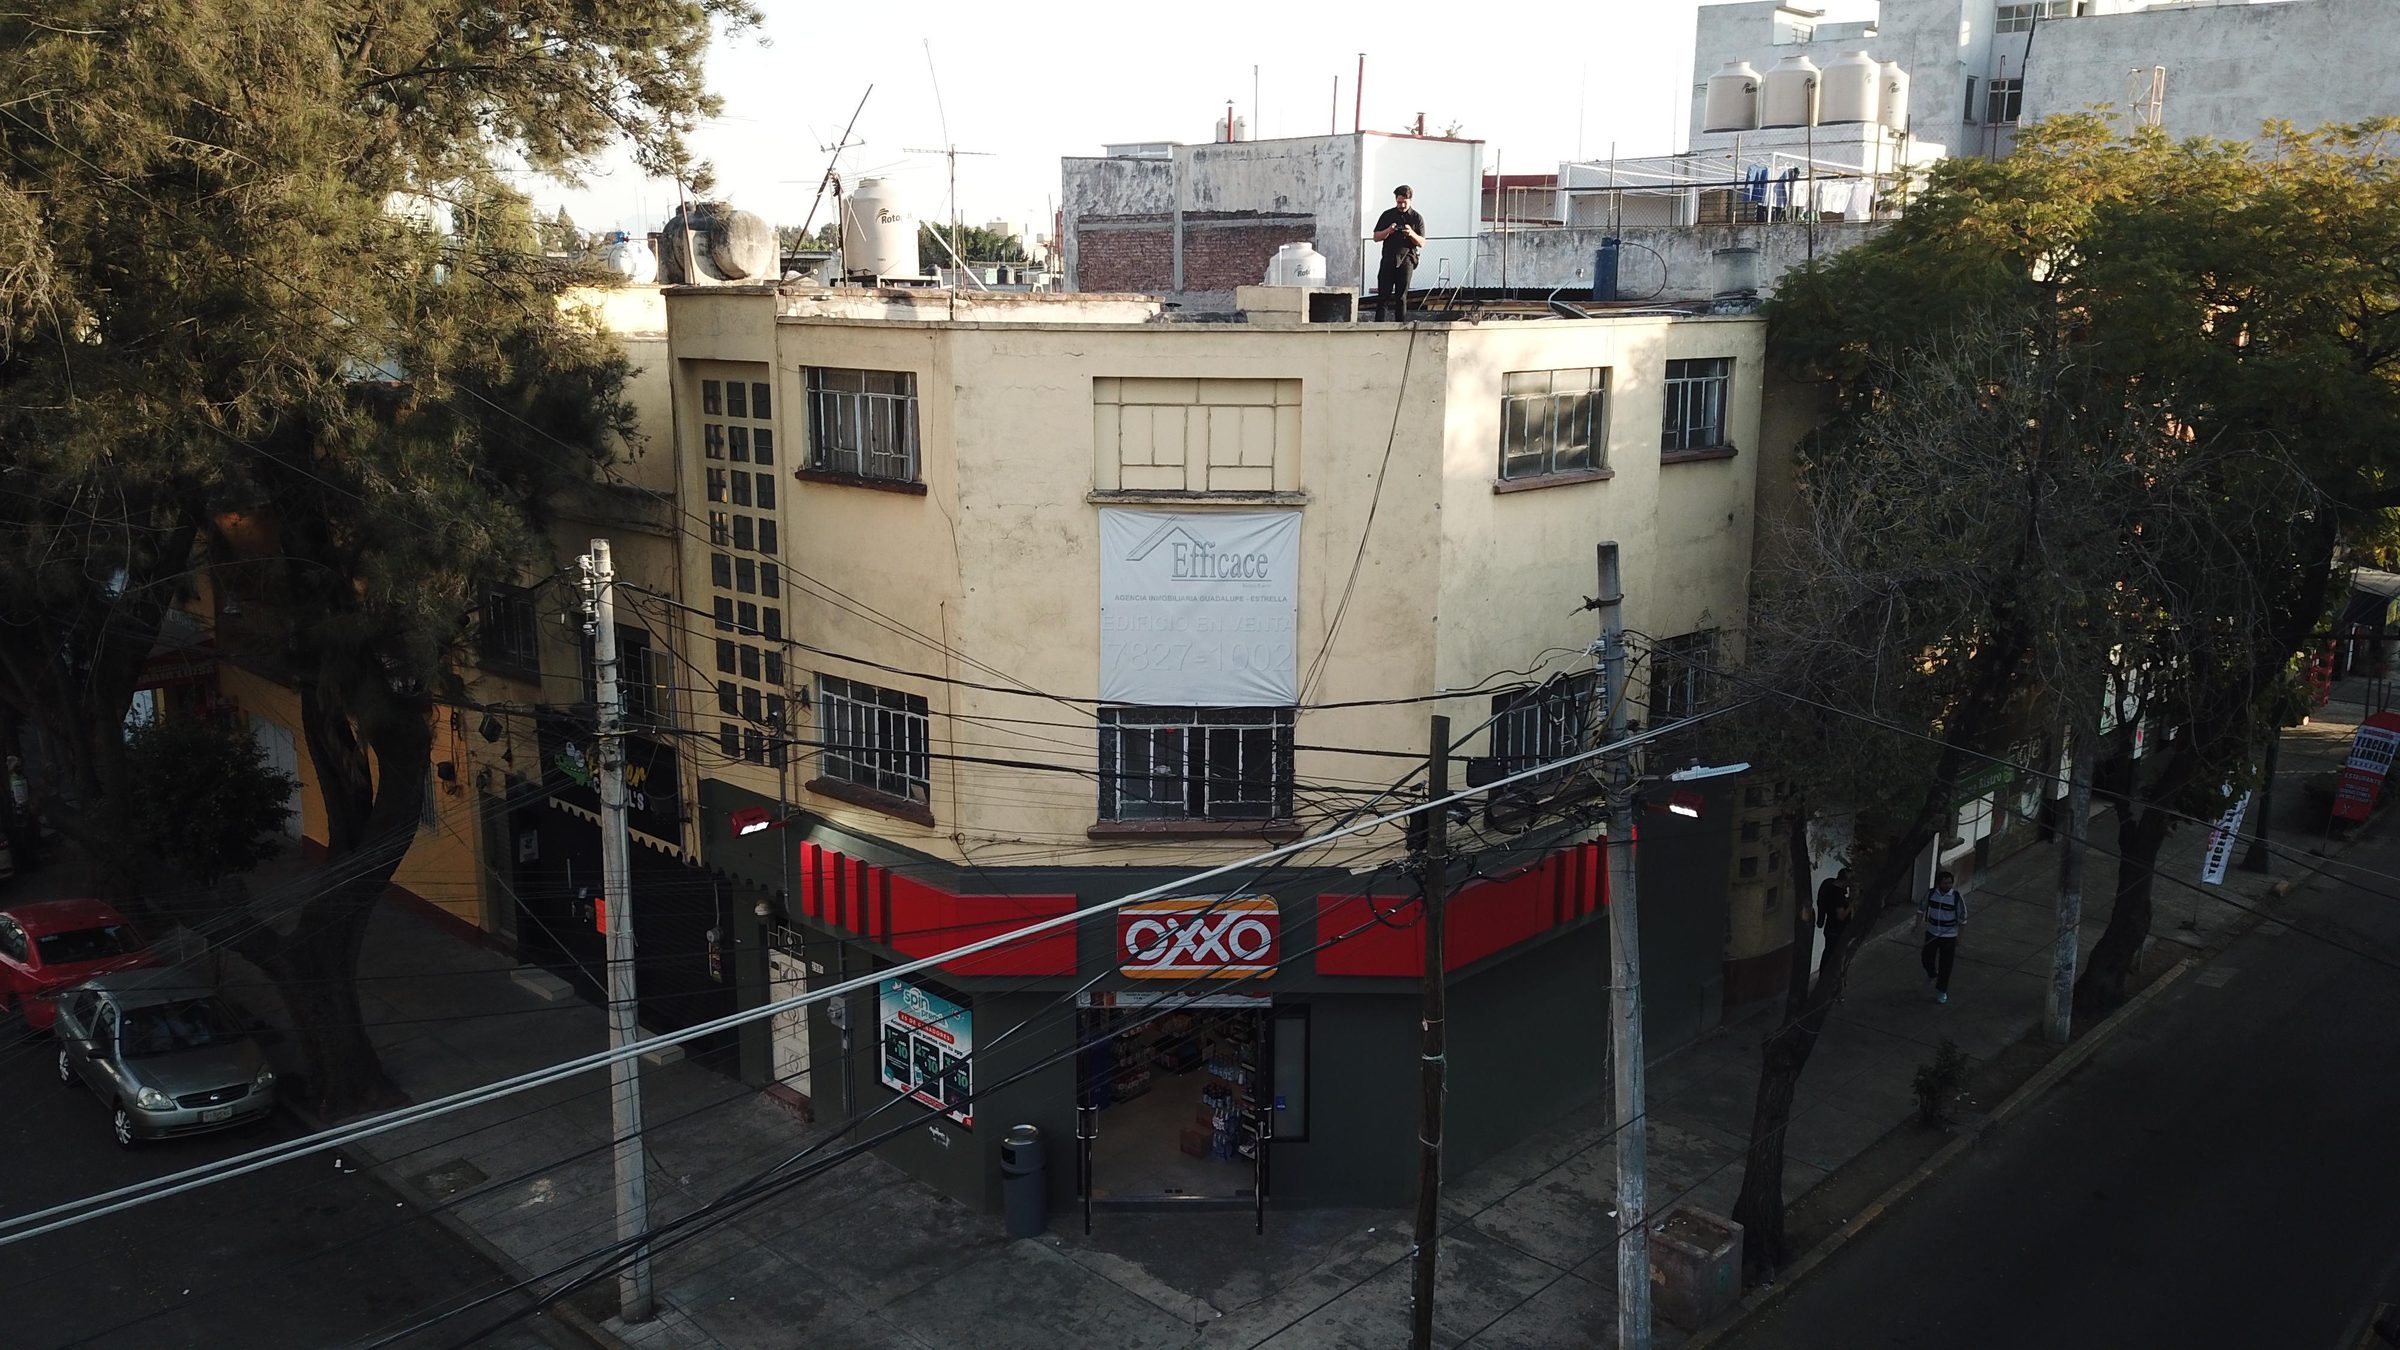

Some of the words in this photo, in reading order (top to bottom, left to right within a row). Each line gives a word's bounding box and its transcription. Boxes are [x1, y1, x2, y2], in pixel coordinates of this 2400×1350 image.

[1171, 540, 1268, 579] Efficace
[1115, 594, 1147, 603] AGENCIA
[1148, 594, 1198, 603] INMOBILIARIA
[1199, 594, 1245, 603] GUADALUPE
[1250, 594, 1288, 603] ESTRELLA
[1102, 615, 1188, 632] EDIFICIO
[1196, 615, 1223, 632] EN
[1231, 615, 1296, 633] VENTA
[1106, 640, 1293, 672] 7827-1002
[1125, 917, 1272, 965] OXXO
[904, 990, 928, 1010] spin
